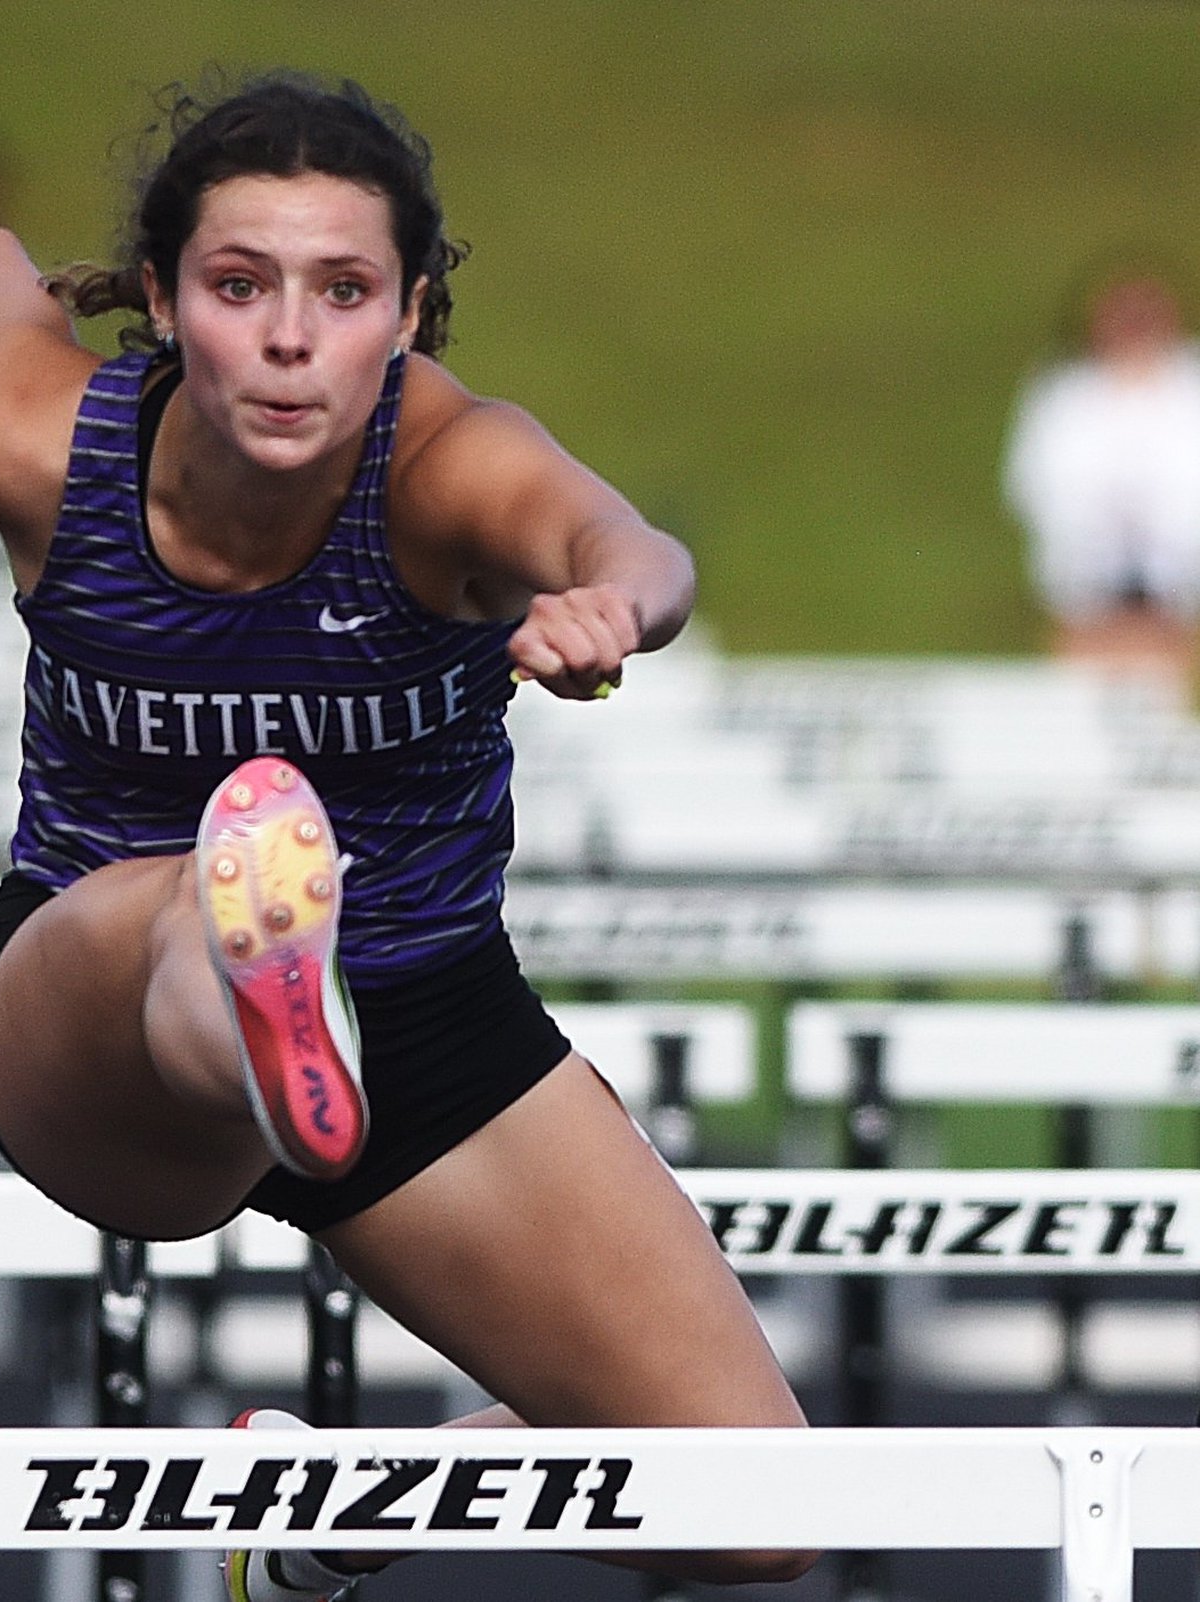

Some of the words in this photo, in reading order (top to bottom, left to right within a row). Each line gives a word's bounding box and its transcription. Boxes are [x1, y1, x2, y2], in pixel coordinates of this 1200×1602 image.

[35, 644, 467, 756] FAYETTEVILLE
[701, 1200, 1185, 1256] BLAZER
[24, 1457, 642, 1531] BLAZER
